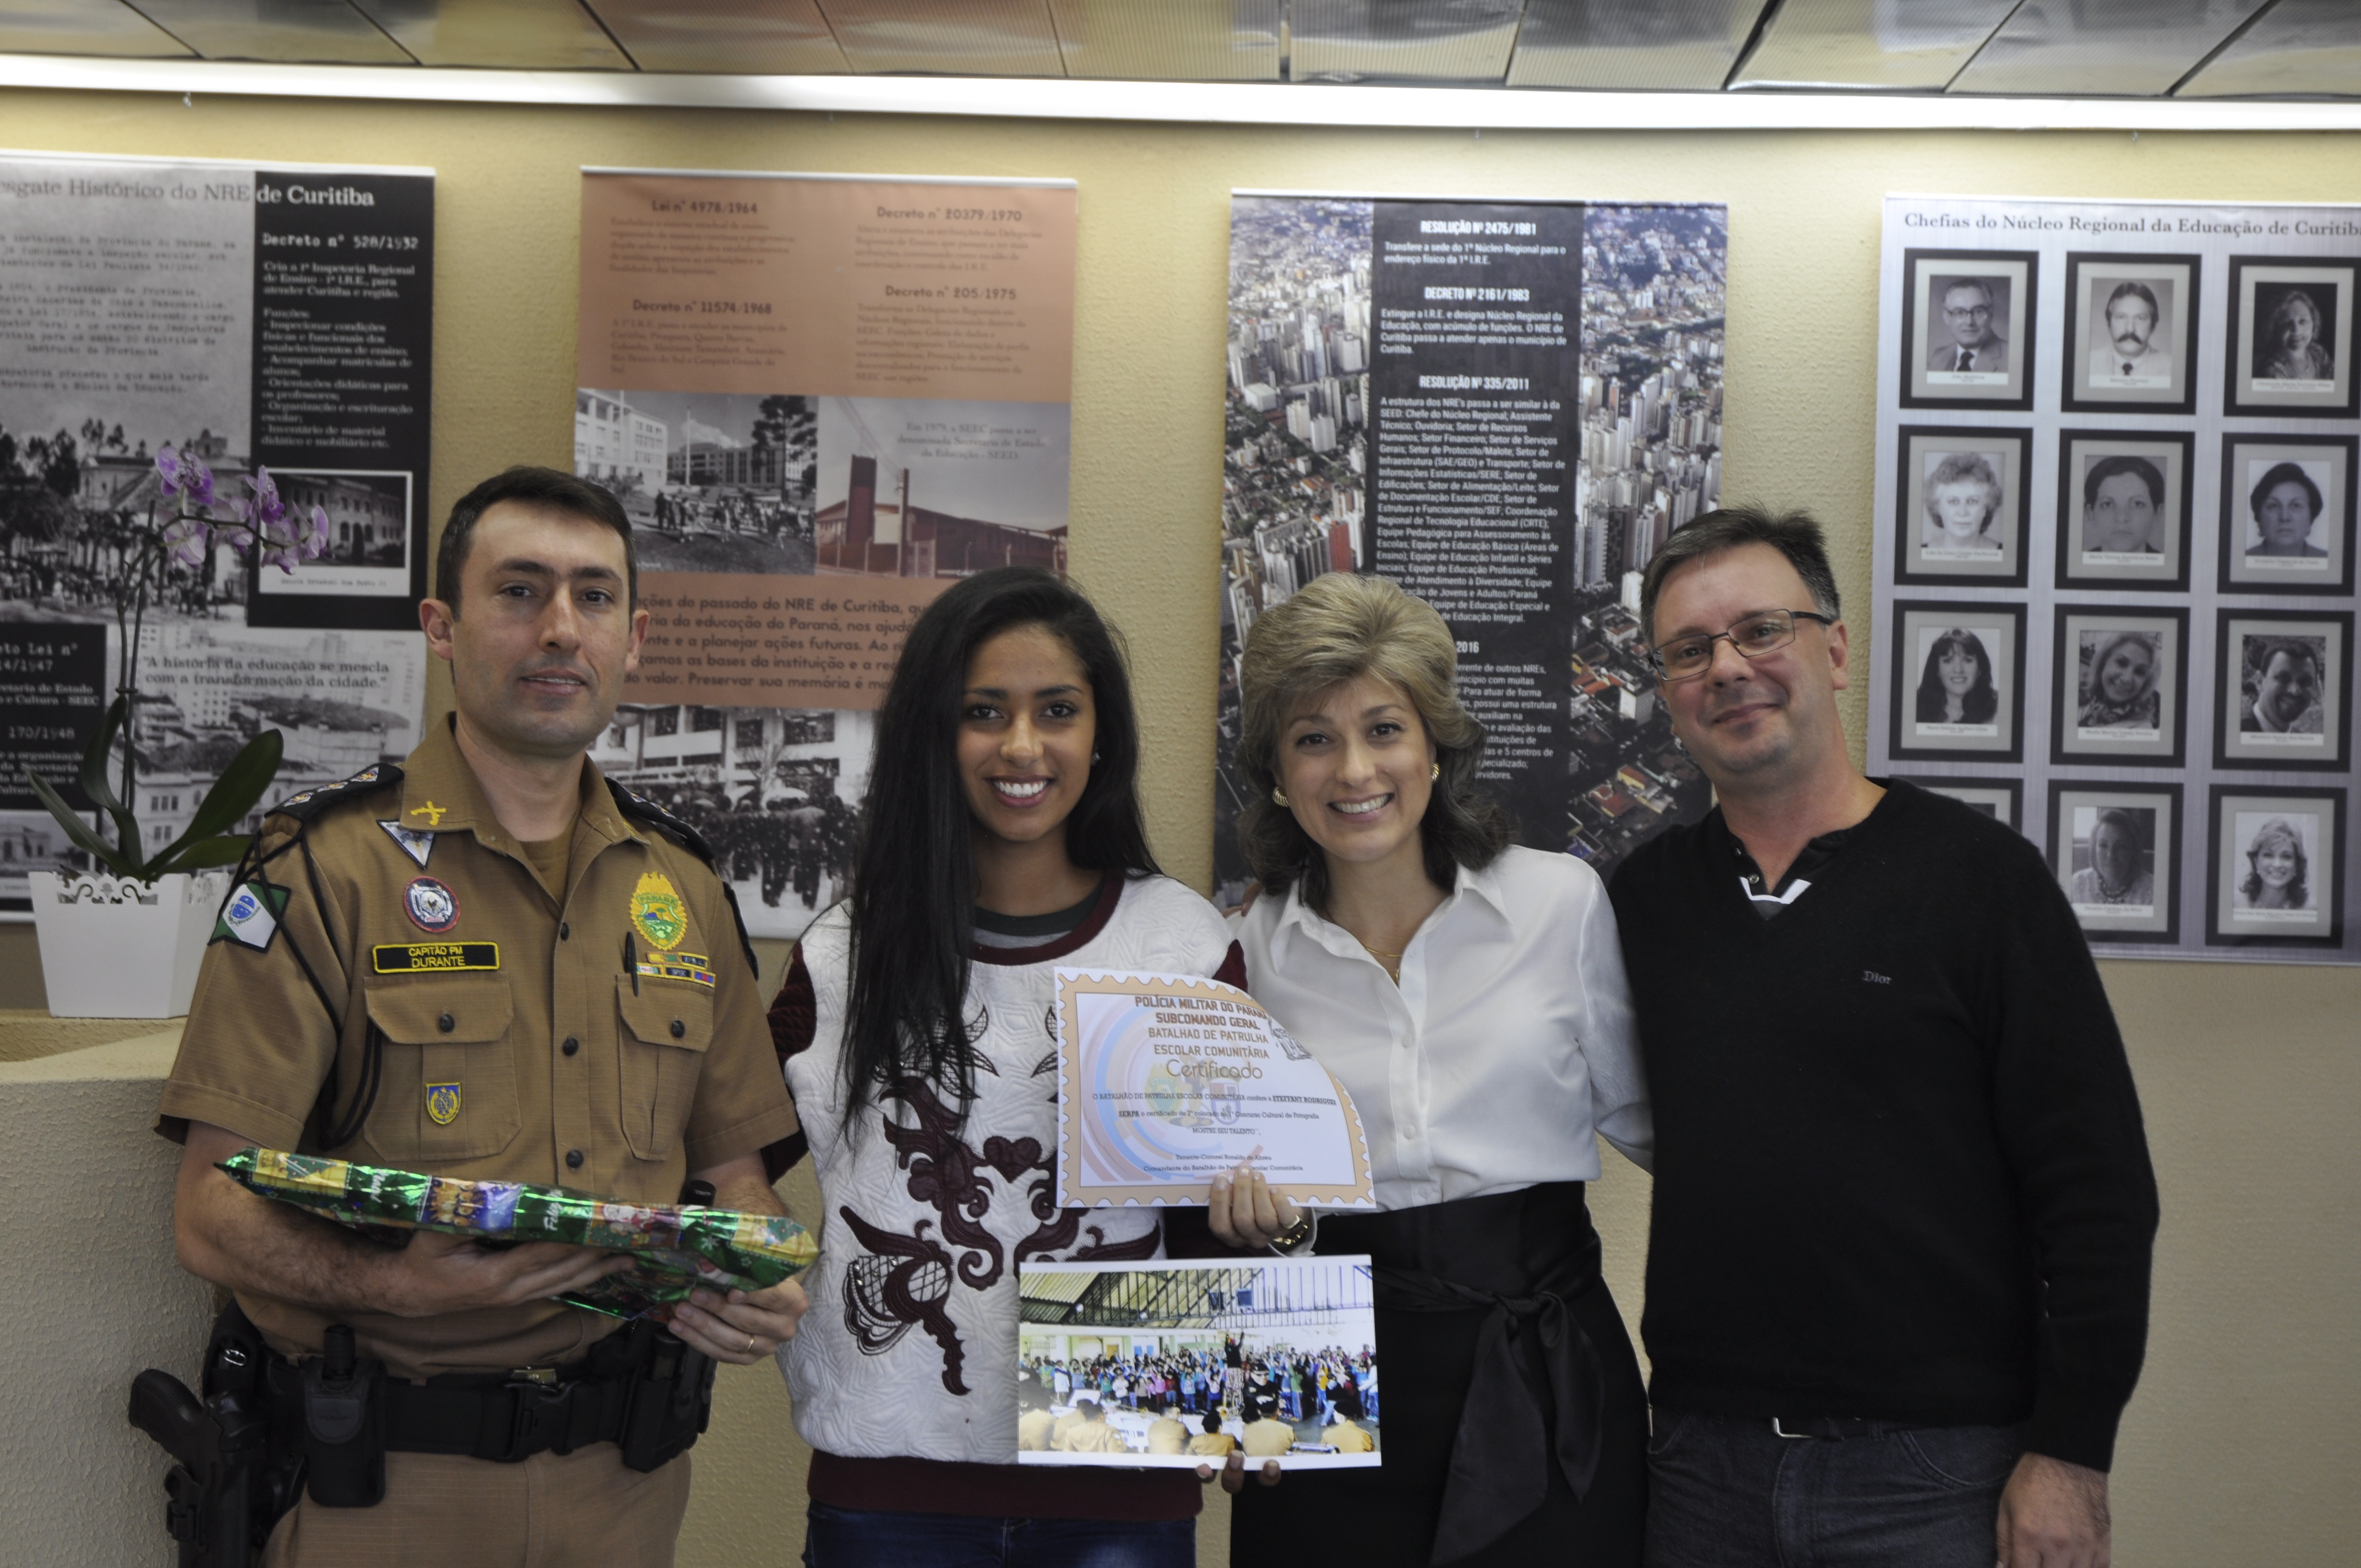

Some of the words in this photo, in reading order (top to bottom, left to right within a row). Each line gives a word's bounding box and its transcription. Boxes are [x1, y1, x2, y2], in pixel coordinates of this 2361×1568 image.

[69, 179, 165, 199] Histórico
[171, 183, 196, 200] do
[203, 184, 251, 202] NRE
[256, 184, 282, 203] de
[287, 185, 375, 206] Curitiba
[652, 200, 670, 211] Lei
[690, 201, 757, 214] 4978/1964
[877, 206, 924, 219] Decreto
[945, 208, 1022, 221] 20379/1970
[1421, 220, 1471, 236] RESOLUÇÃO
[1905, 213, 1970, 228] Chefias
[1976, 215, 1996, 228] do
[2003, 215, 2063, 230] Núcleo
[2069, 216, 2145, 235] Regional
[2151, 219, 2172, 232] da
[2178, 219, 2262, 237] Educação
[2268, 221, 2289, 235] de
[262, 232, 320, 247] Decreto
[1385, 241, 1422, 252] Transfere
[1431, 243, 1450, 252] sede
[1452, 243, 1463, 252] do
[1475, 244, 1503, 254] Núcleo
[1505, 244, 1539, 256] Regional
[1541, 247, 1558, 256] para
[885, 285, 933, 297] Decreto
[954, 287, 1016, 300] 205/1975
[1424, 287, 1464, 300] DECRETO
[633, 300, 681, 312] Decreto
[701, 301, 771, 314] 11574/1968
[1381, 308, 1416, 320] Extingue
[1454, 309, 1485, 322] designa
[1487, 311, 1515, 321] Núcleo
[1517, 311, 1551, 323] Regional
[1552, 312, 1563, 322] da
[1419, 375, 1470, 391] RESOLUÇÃO
[1484, 378, 1528, 390] 335/2011
[1378, 527, 1404, 537] Equipe
[1406, 528, 1452, 539] Pedagógica
[1454, 530, 1472, 539] para
[1473, 530, 1539, 539] Assessoramento
[1408, 563, 1435, 574] Equipe
[1437, 564, 1447, 573] de
[1449, 565, 1488, 575] Educação
[677, 595, 695, 607] do
[700, 597, 757, 612] passado
[763, 597, 780, 609] do
[786, 598, 815, 610] NRE
[820, 600, 837, 611] de
[844, 600, 902, 614] Curitiba,
[673, 613, 690, 626] da
[696, 615, 761, 631] educação
[767, 617, 784, 629] do
[790, 617, 841, 632] Paraná,
[847, 622, 871, 631] nos
[702, 634, 758, 651] planejar
[765, 636, 804, 652] ações
[810, 636, 862, 650] futuras.
[869, 639, 888, 651] Ao
[1457, 641, 1479, 653] 2016
[225, 658, 242, 669] da
[248, 659, 315, 673] educação
[320, 663, 334, 671] se
[340, 662, 389, 673] mescla
[687, 657, 701, 665] as
[708, 653, 746, 667] bases
[751, 655, 769, 667] da
[774, 656, 844, 672] instituição
[850, 661, 857, 669] e
[145, 674, 175, 683] com
[307, 676, 324, 686] da
[689, 672, 753, 686] Preservar
[760, 677, 782, 686] sua
[788, 676, 850, 688] memória
[1464, 688, 1481, 696] Para
[1484, 688, 1504, 696] atuar
[1518, 688, 1541, 697] forma
[1474, 701, 1500, 710] possui
[1521, 701, 1557, 710] estrutura
[409, 946, 447, 956] CAPITÃO
[449, 946, 463, 955] PM
[412, 956, 465, 968] DURANTE
[1862, 970, 1892, 985] Dior
[1135, 994, 1176, 1009] POLÍCIA
[1179, 998, 1218, 1011] MILITAR
[1221, 1002, 1234, 1012] DO
[1156, 1012, 1227, 1026] SUBCOMANDO
[1230, 1017, 1260, 1030] GERAL
[1204, 1030, 1217, 1039] DE
[1220, 1031, 1269, 1044] PATRULHA
[1154, 1044, 1201, 1055] ESCOLAR
[1205, 1046, 1269, 1059] COMUNITÁRIA
[1167, 1059, 1263, 1079] Certificado
